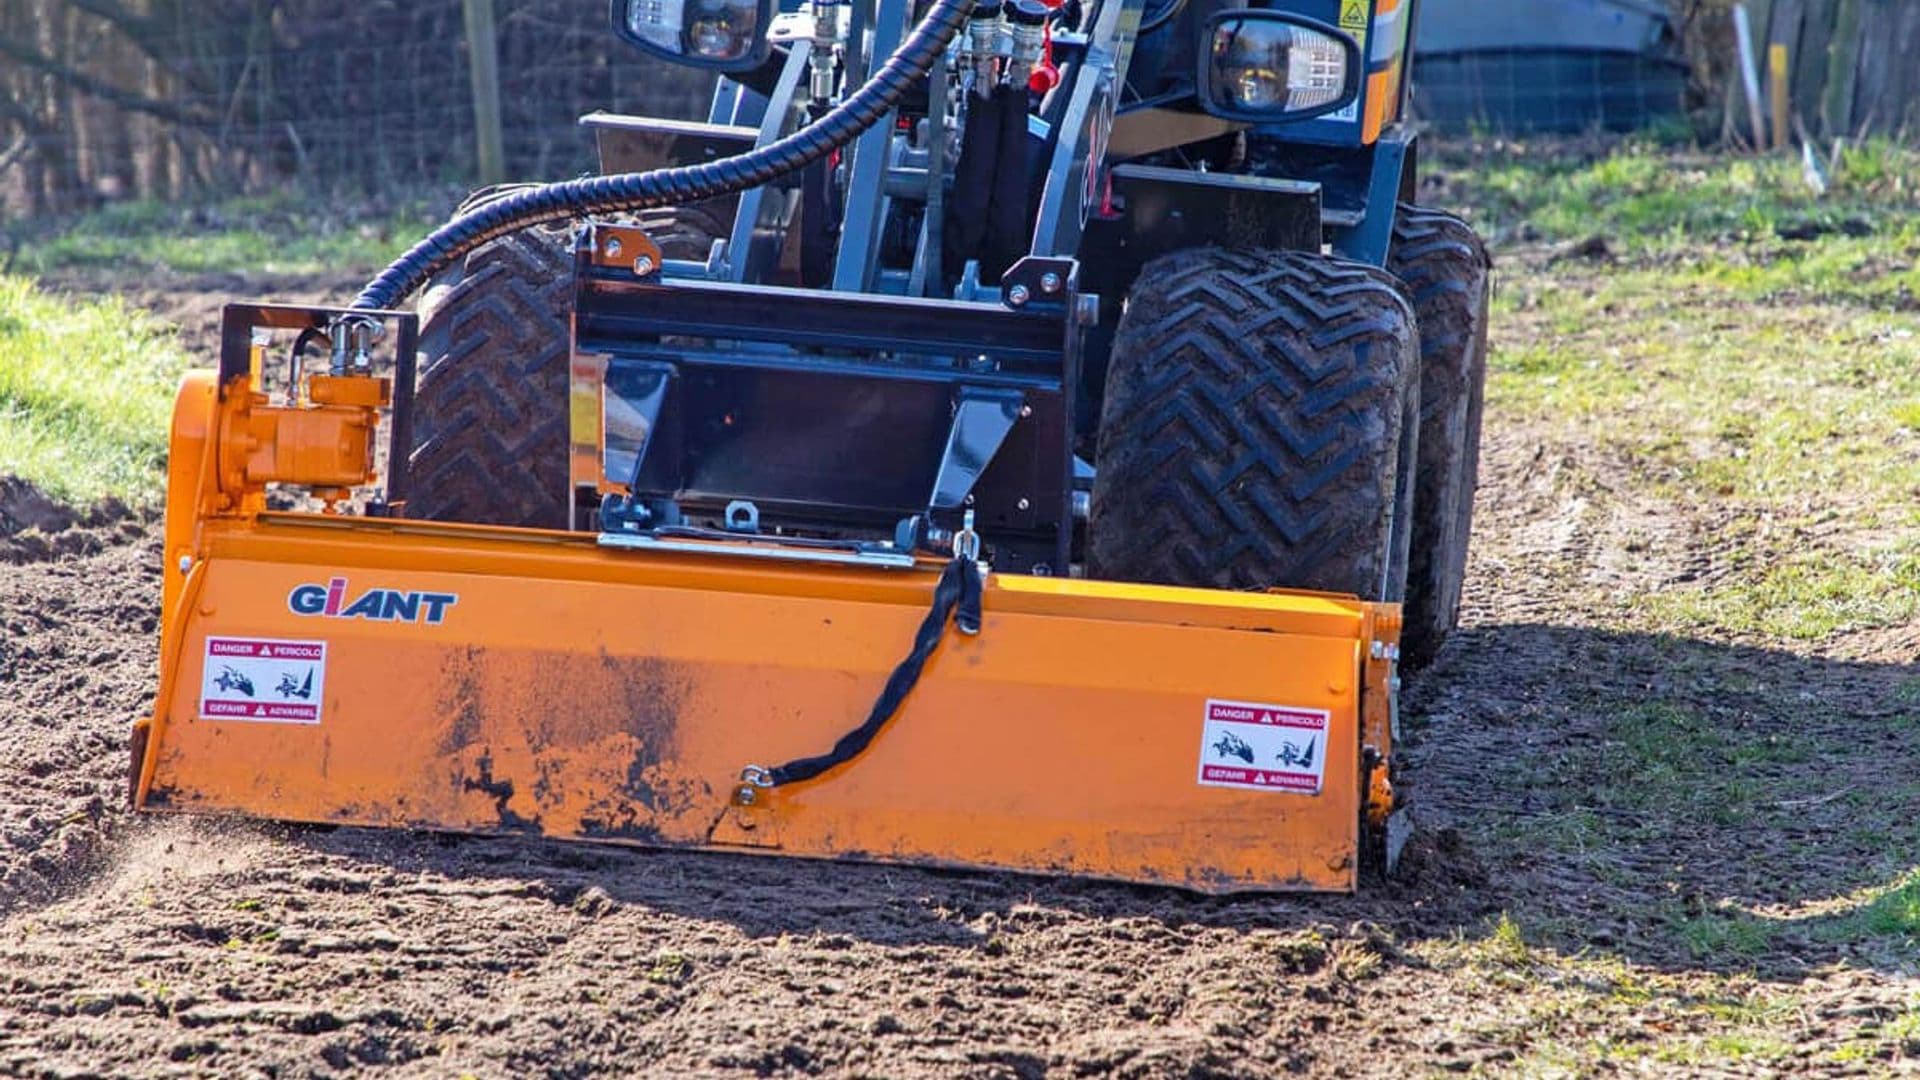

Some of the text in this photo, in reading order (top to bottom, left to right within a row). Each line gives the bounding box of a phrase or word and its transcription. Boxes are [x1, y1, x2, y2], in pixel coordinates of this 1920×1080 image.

[213, 643, 321, 657] DANGER PERICOLO
[209, 704, 314, 717] GEFAHR ADVARSEL
[1213, 708, 1324, 727] DANGER PERICOLO
[1207, 768, 1316, 787] GEFAHR ADVARSEL
